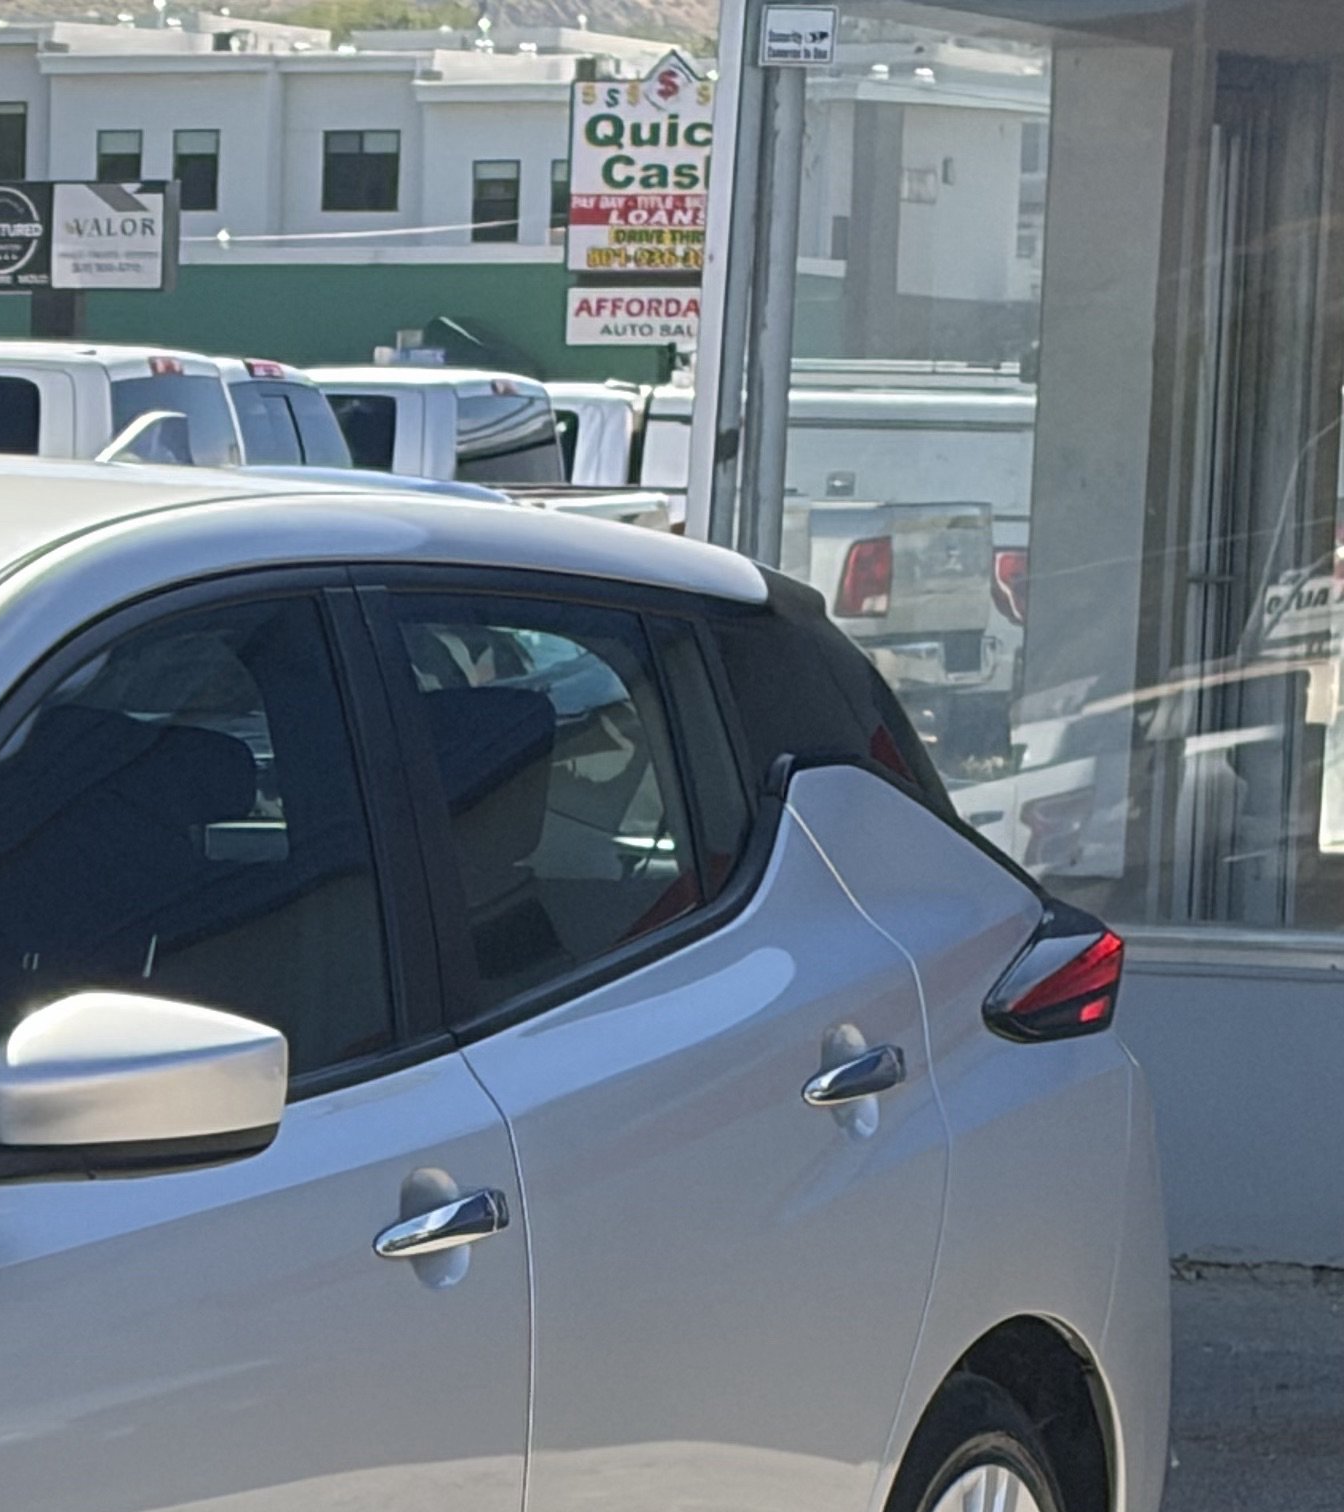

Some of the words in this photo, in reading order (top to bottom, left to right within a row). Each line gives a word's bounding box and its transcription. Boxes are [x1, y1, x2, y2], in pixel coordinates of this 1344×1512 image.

[585, 113, 712, 150] Quic
[73, 217, 156, 237] VALOR
[614, 229, 663, 244] DRIVE
[574, 297, 700, 318] AFFORDA
[600, 323, 653, 337] AUTO
